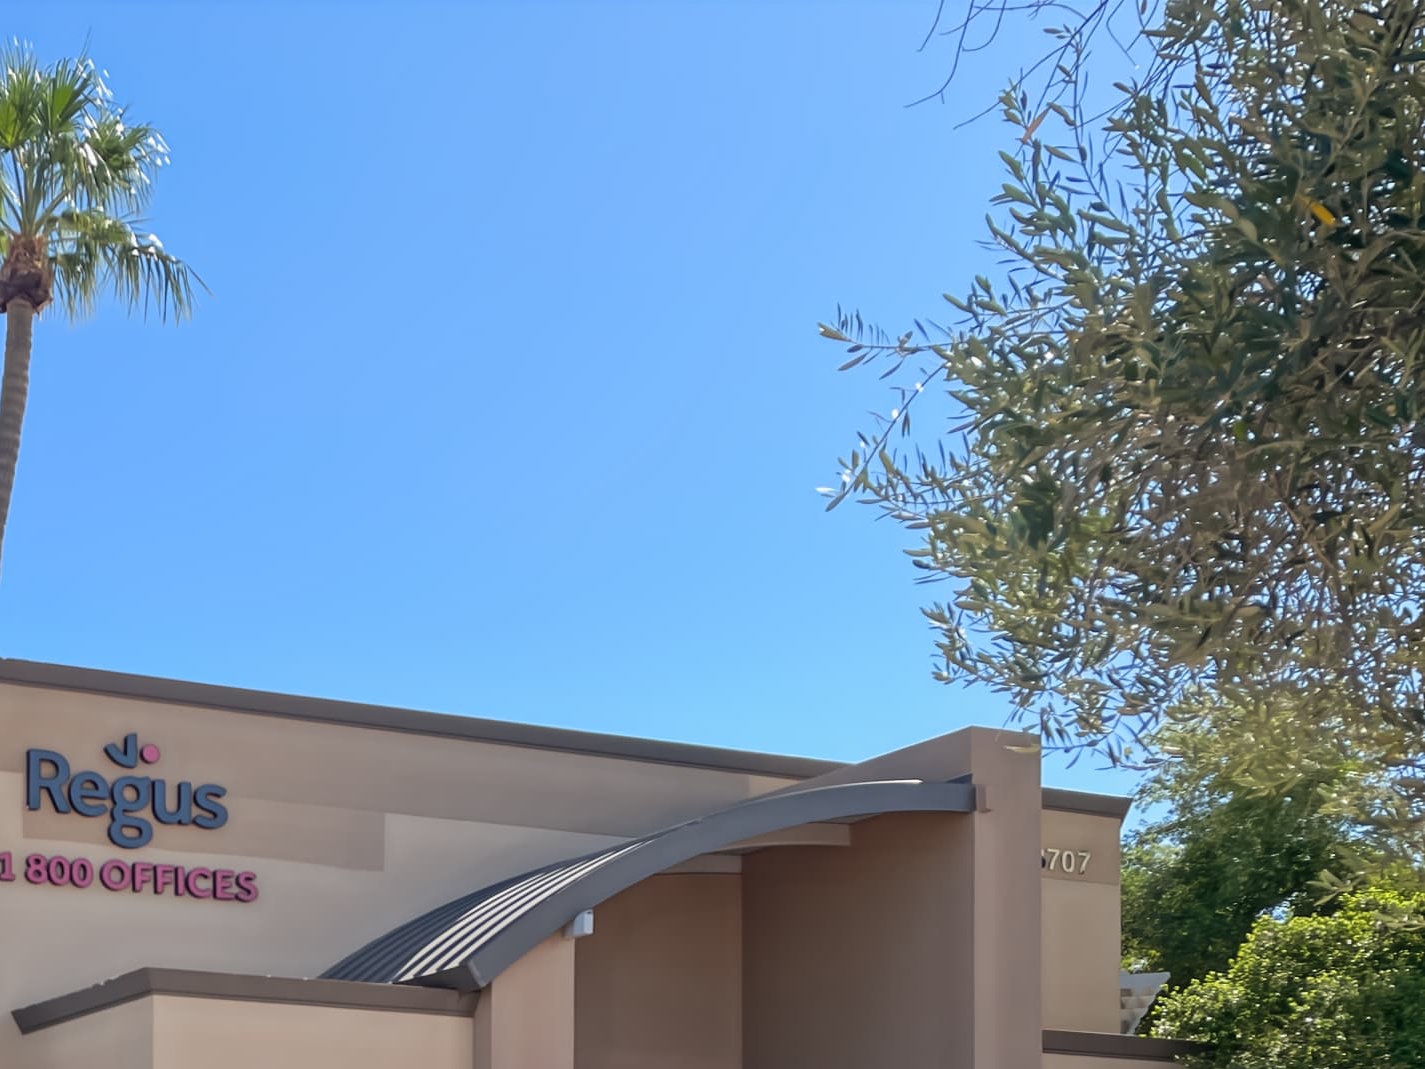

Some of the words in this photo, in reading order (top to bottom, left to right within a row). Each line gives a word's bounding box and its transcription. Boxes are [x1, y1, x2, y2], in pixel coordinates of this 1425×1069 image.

[26, 748, 229, 849] Regus
[24, 854, 93, 888] 800
[99, 859, 259, 902] OFFICES
